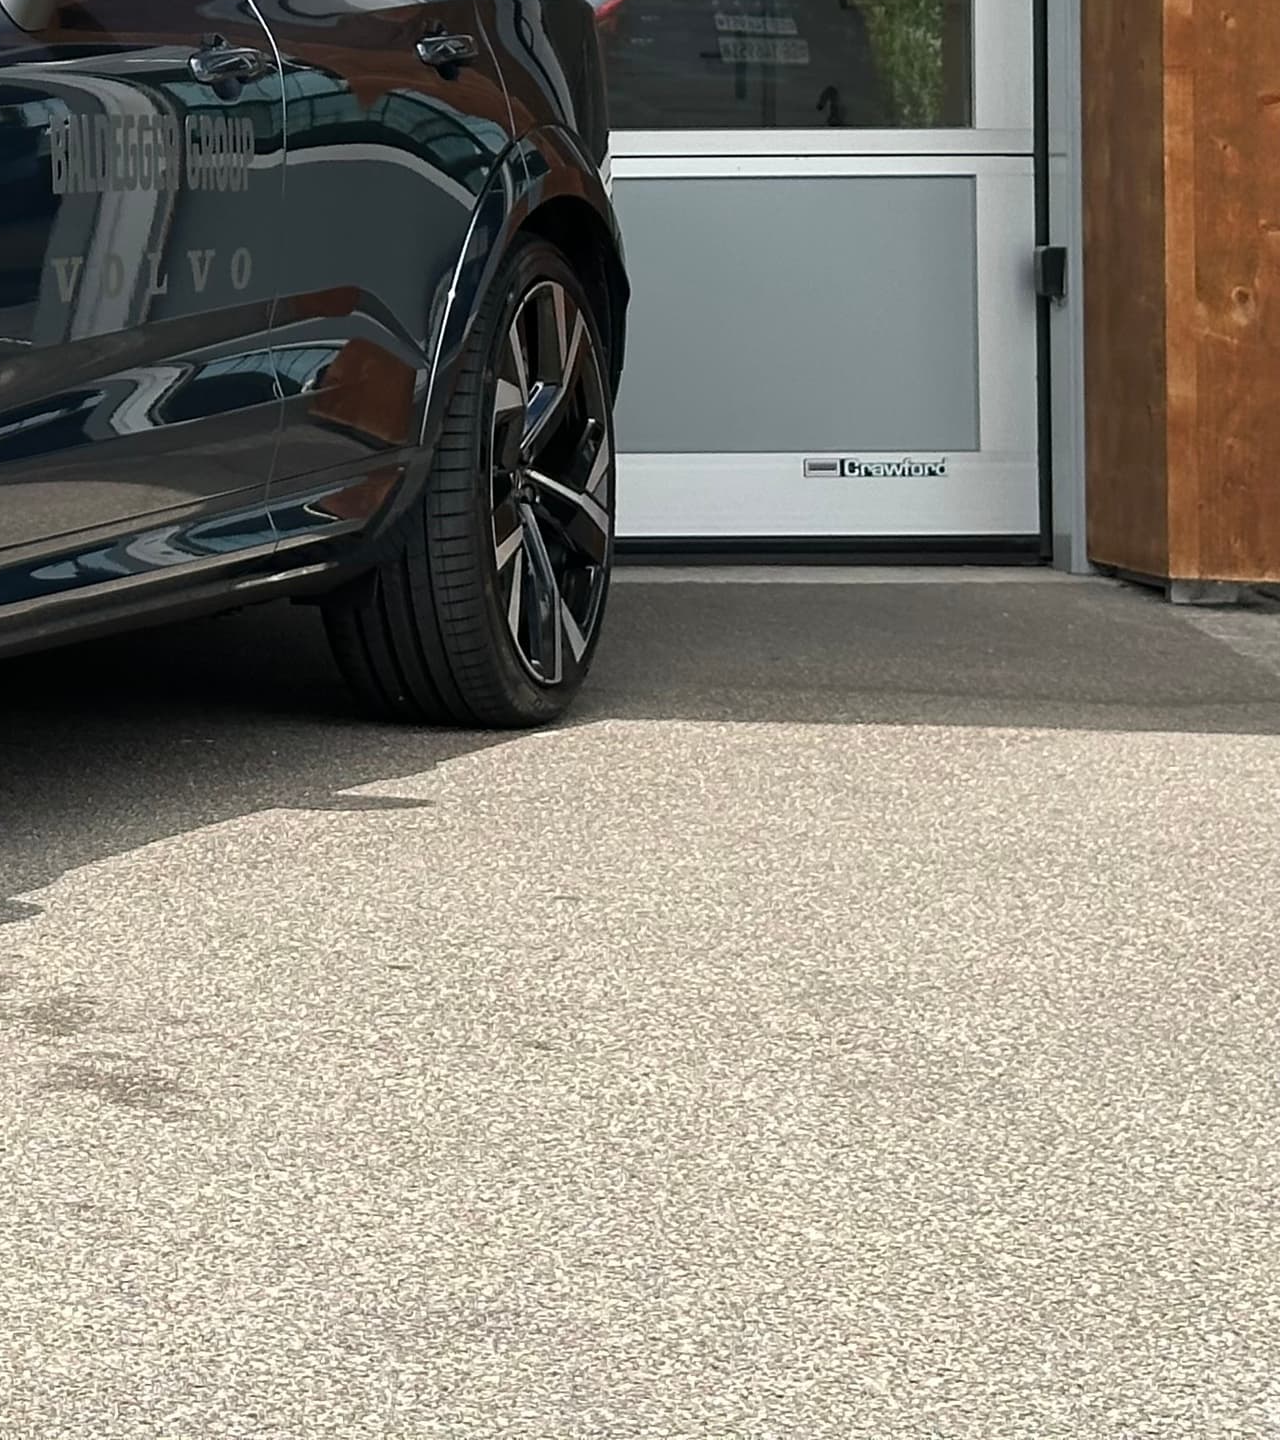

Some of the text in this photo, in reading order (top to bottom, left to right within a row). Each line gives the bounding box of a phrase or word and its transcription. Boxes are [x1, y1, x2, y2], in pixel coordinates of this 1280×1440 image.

[48, 113, 256, 195] BALDEGGER GROUP
[51, 247, 253, 302] VOLVO
[843, 457, 948, 477] Crawford
